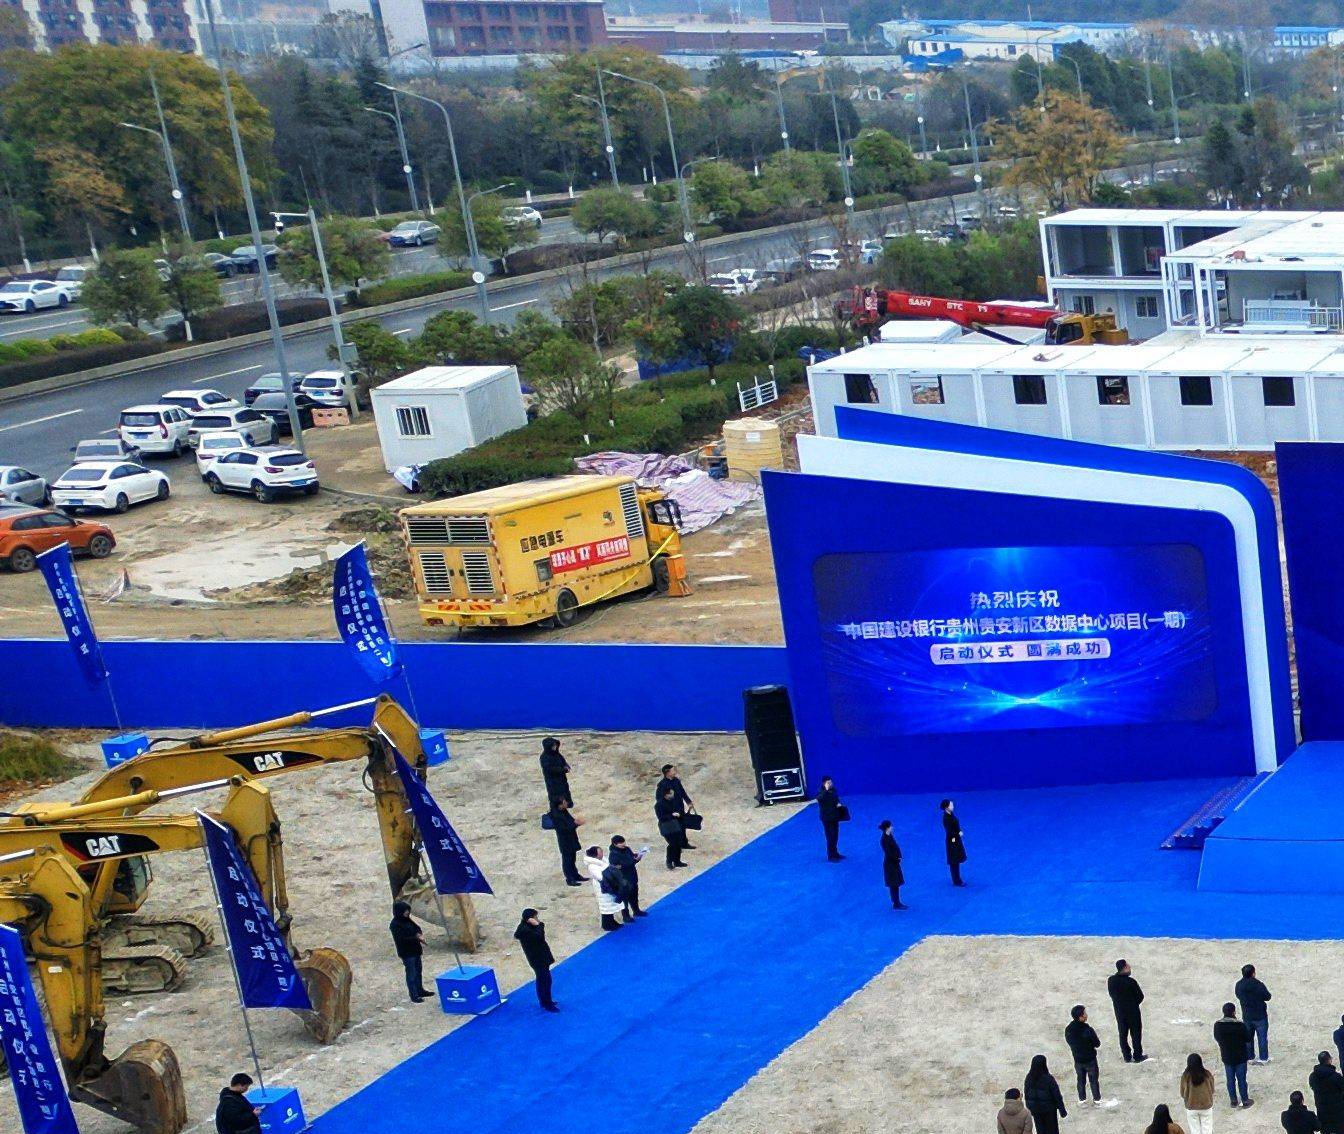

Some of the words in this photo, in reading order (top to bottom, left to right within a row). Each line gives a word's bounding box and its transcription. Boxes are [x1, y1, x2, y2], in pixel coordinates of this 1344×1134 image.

[970, 589, 1061, 609] 热烈庆祝
[939, 645, 1014, 660] 启动仪式
[1026, 642, 1101, 657] 圆满成功
[254, 751, 285, 772] CAT
[85, 835, 122, 857] CAT
